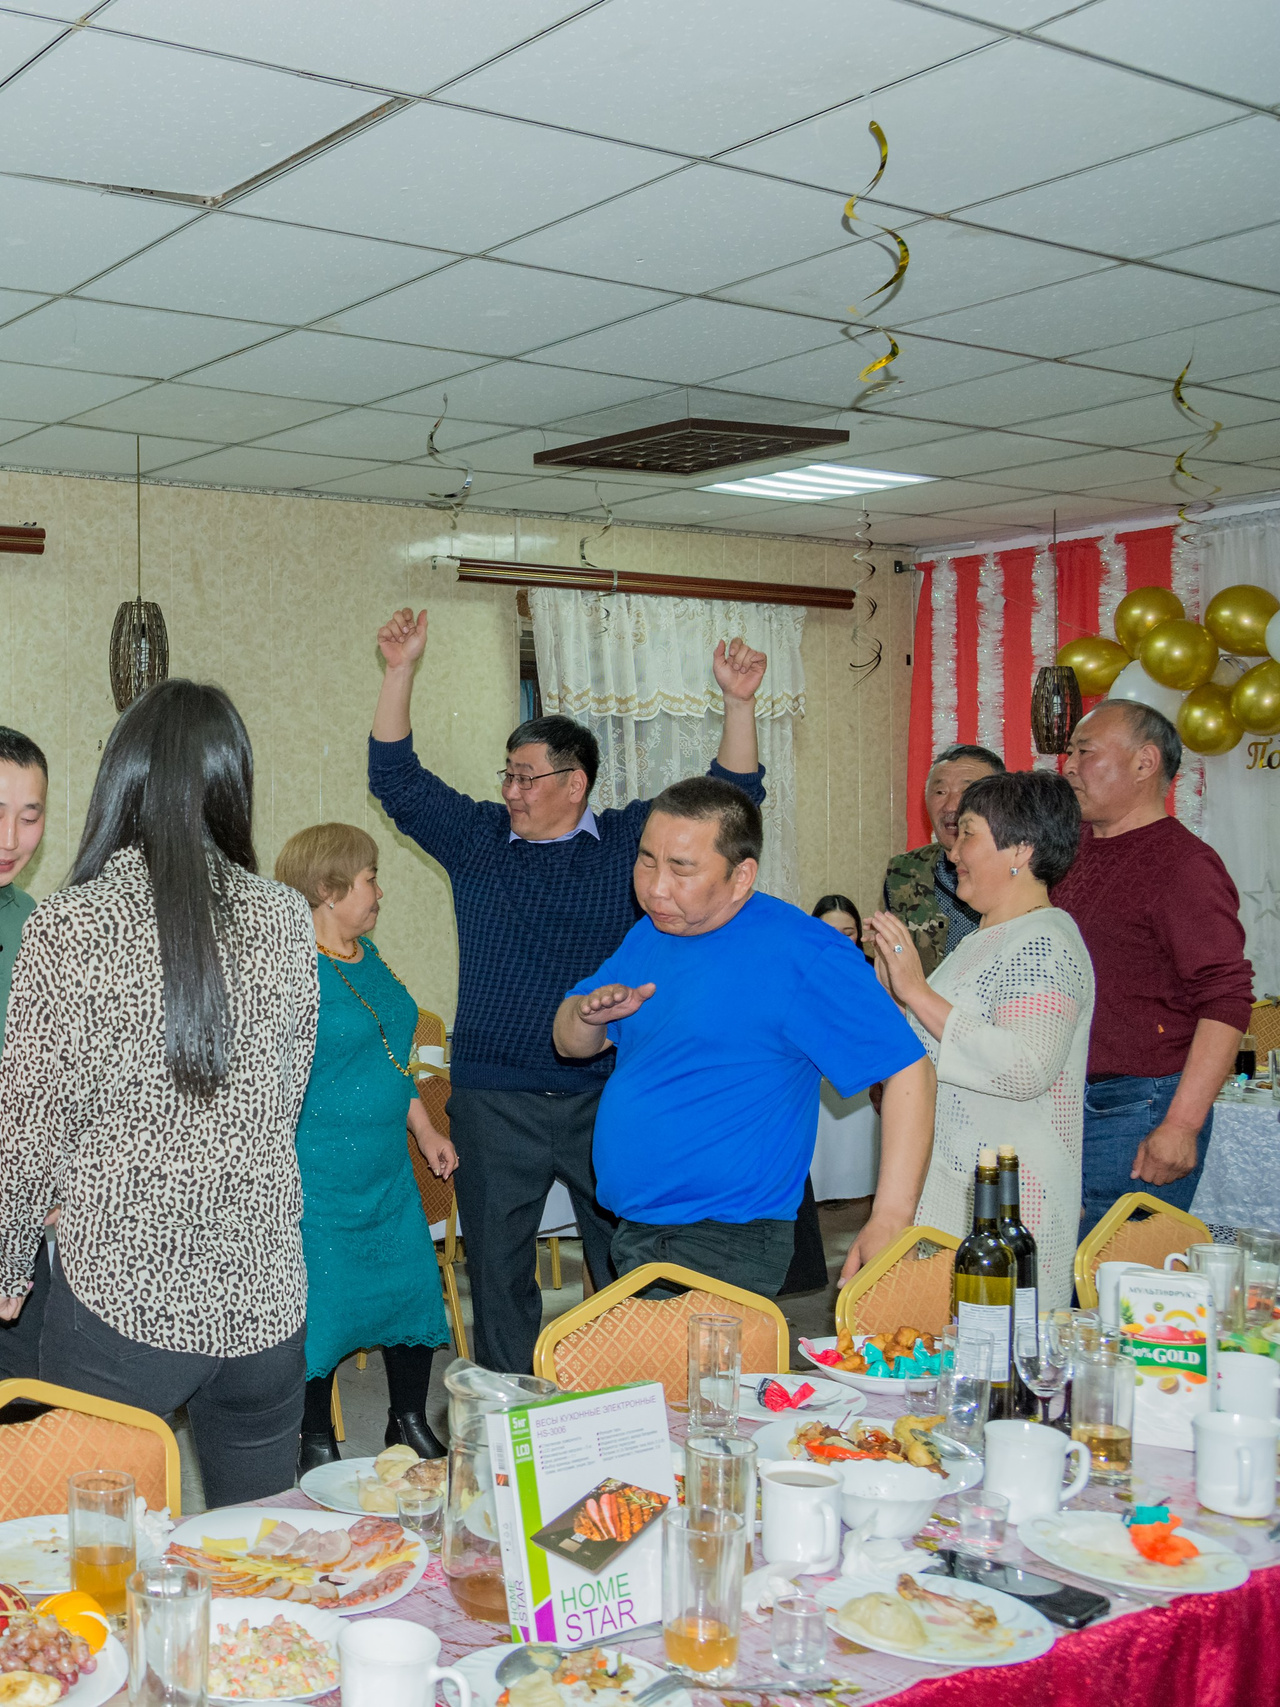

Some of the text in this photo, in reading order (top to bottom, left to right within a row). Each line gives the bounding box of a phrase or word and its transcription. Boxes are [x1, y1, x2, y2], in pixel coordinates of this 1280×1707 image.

[1152, 1347, 1201, 1365] GOLD
[535, 1395, 656, 1428] ВЕСЫ КУХОННЫЕ ЭЛЕКТРОННЫЕ
[537, 1425, 567, 1438] HS-3006
[515, 1443, 531, 1458] LCD
[507, 1581, 520, 1622] HOME
[515, 1580, 528, 1623] STAR
[560, 1572, 632, 1614] HOME
[565, 1599, 638, 1643] STAR
